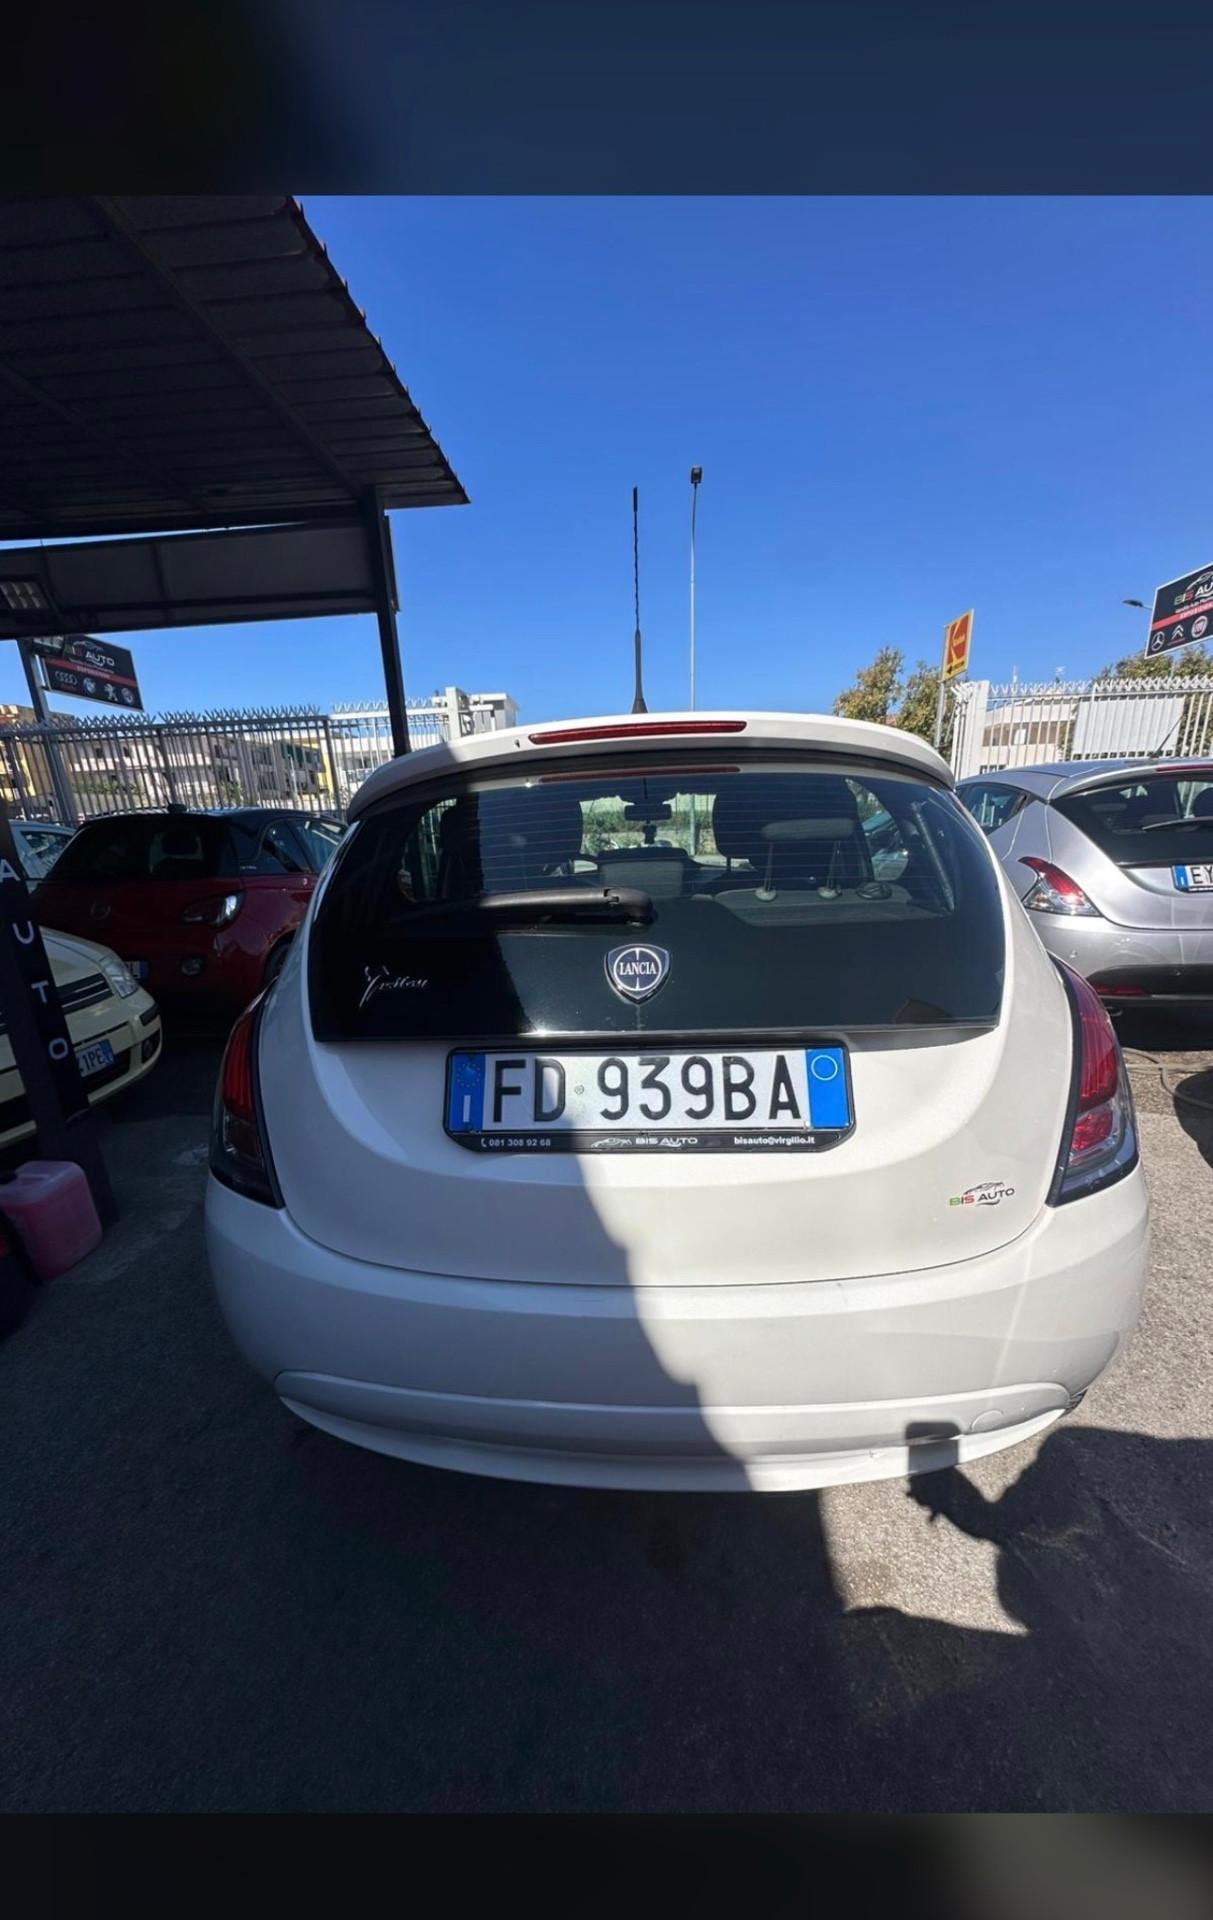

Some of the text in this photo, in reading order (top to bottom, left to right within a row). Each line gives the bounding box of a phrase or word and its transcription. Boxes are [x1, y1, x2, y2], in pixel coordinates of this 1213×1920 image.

[85, 651, 115, 667] AUTO
[619, 961, 657, 976] LANCIA
[492, 1055, 801, 1123] FD 939BA
[526, 1138, 538, 1146] 92
[635, 1137, 698, 1146] BIS AUTO
[949, 1188, 1015, 1206] BIS AUTO
